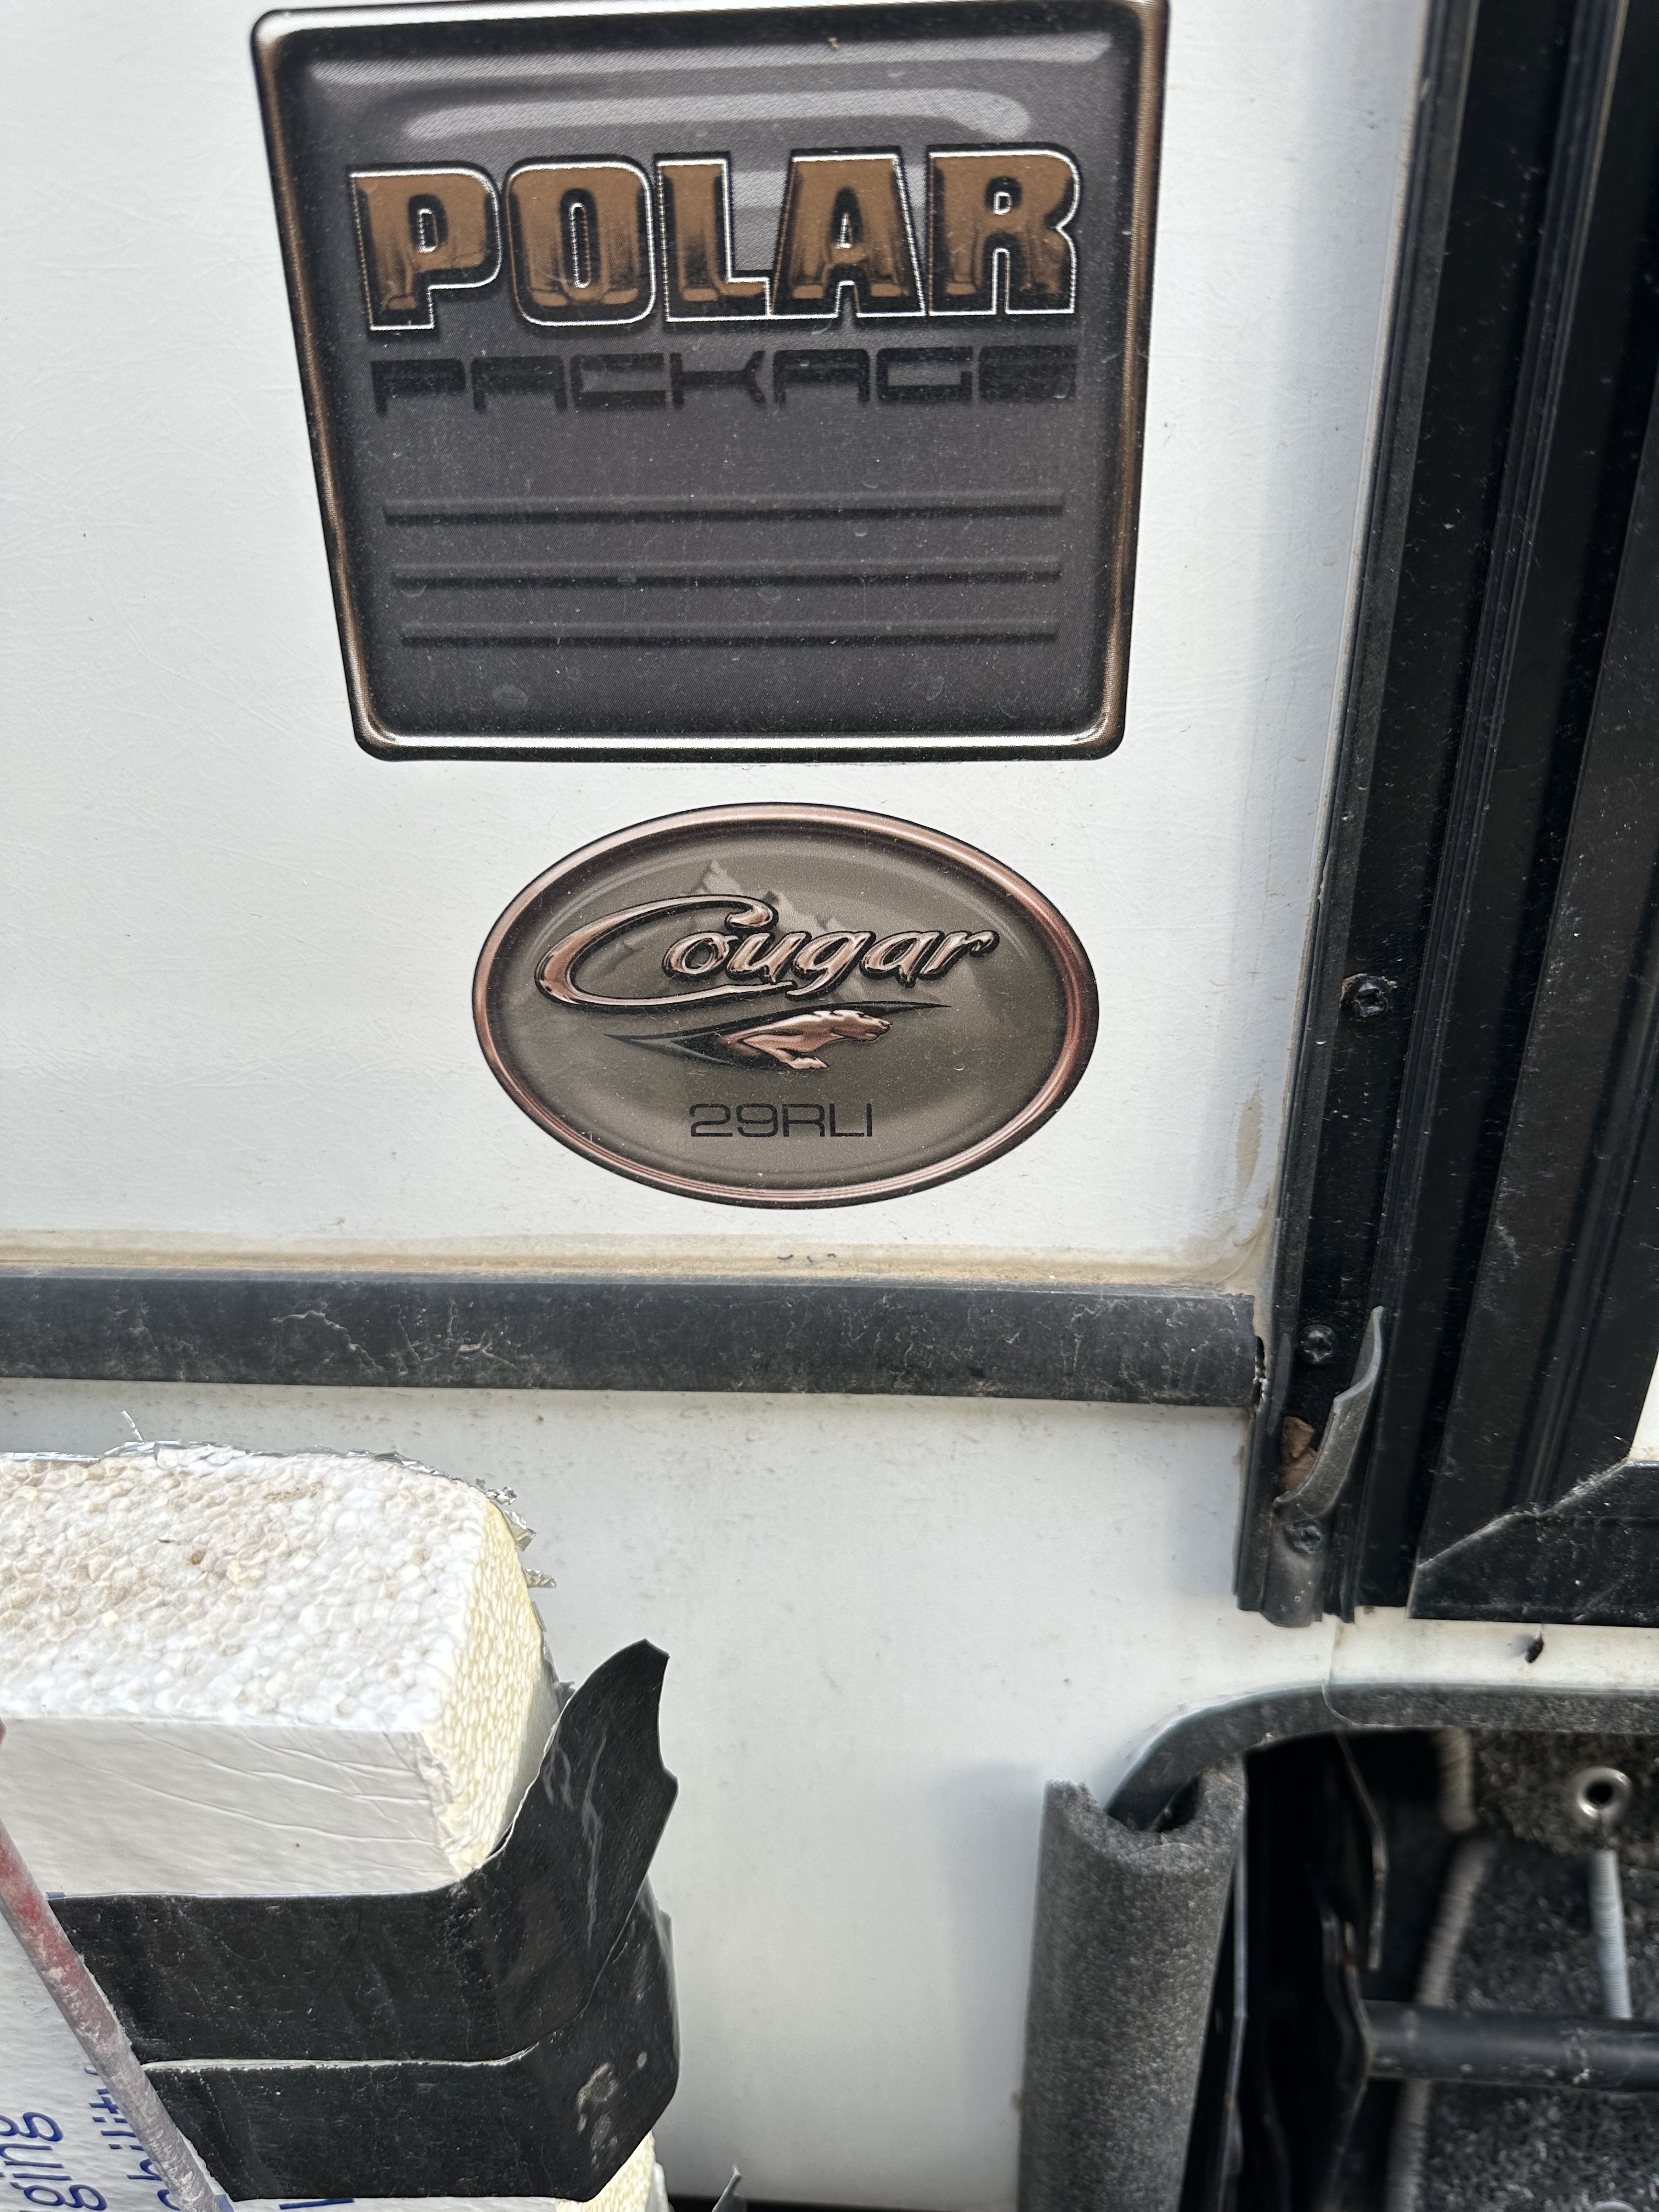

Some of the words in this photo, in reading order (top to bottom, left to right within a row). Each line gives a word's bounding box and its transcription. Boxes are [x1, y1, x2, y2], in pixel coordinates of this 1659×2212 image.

[348, 147, 1080, 332] POLAR
[370, 346, 1078, 415] PACKAGE
[534, 894, 1000, 1013] Cougar
[689, 1103, 873, 1138] 29RLI
[0, 2112, 108, 2212] ging
